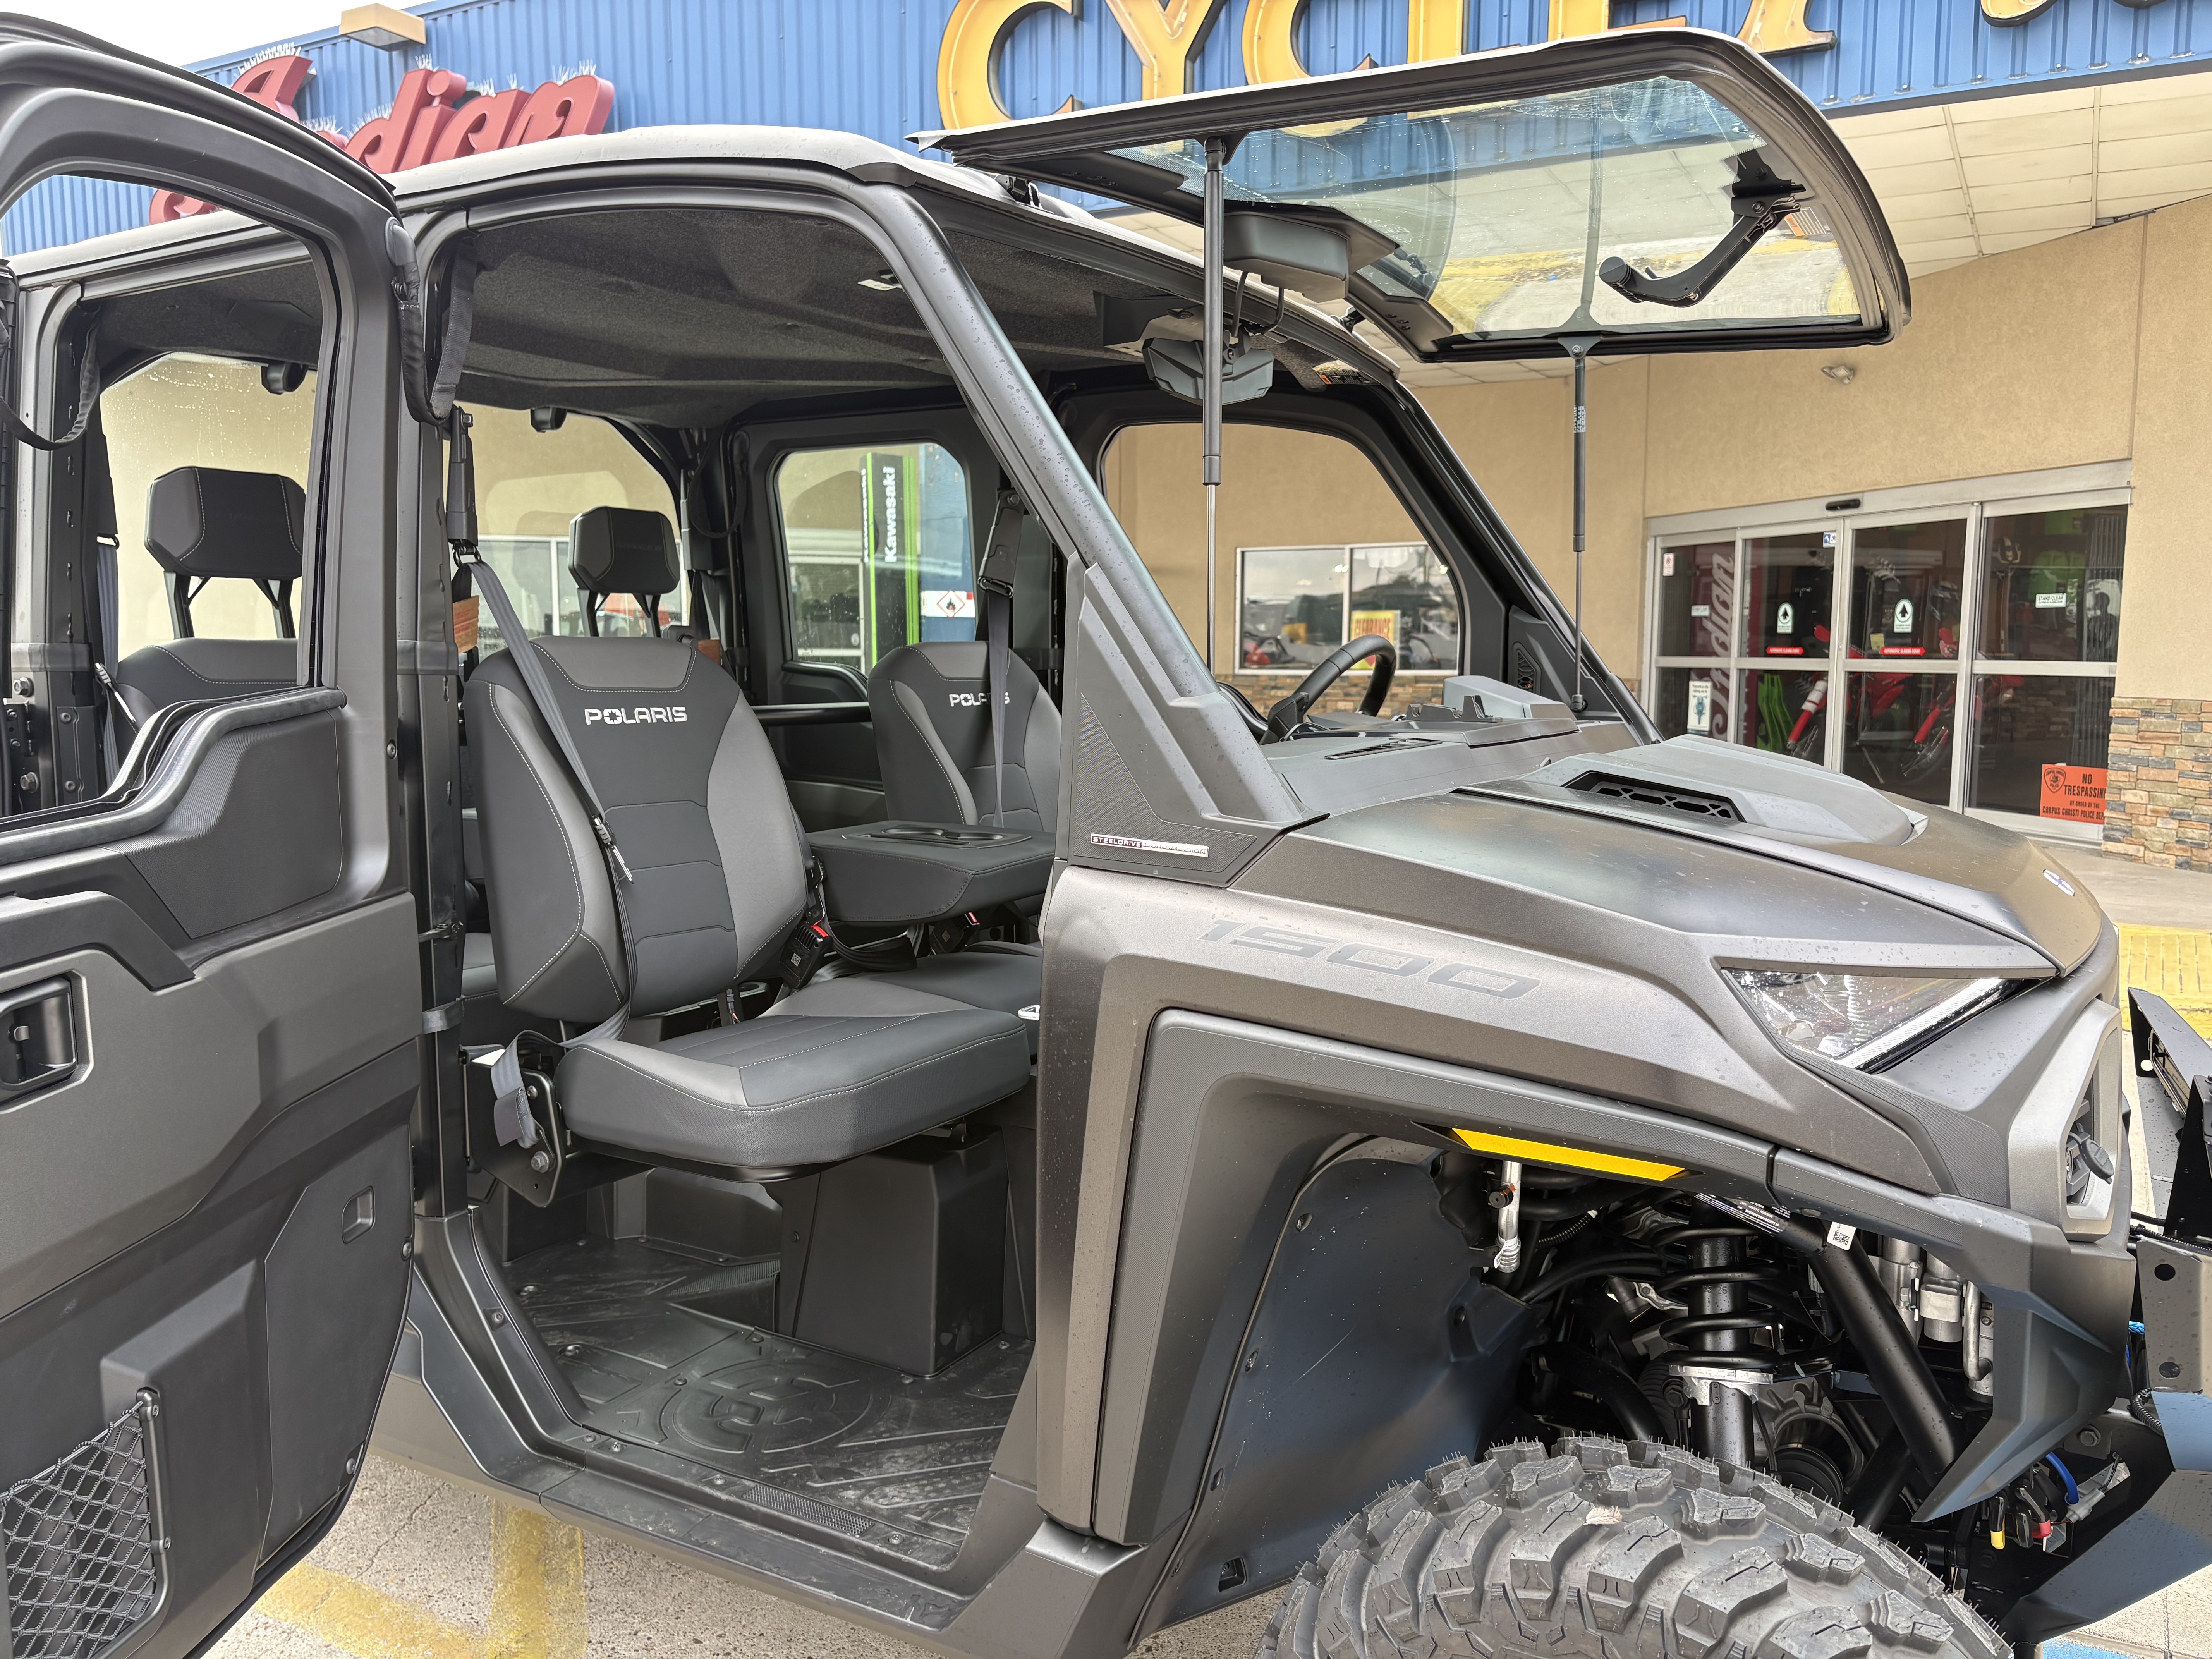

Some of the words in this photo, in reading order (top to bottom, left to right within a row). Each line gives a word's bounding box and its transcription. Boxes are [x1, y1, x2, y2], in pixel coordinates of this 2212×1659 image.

[883, 466, 897, 563] Kawasaki
[949, 692, 1010, 707] POLA
[584, 707, 688, 725] POLARIS
[2082, 773, 2092, 784] NO
[2043, 806, 2060, 815] CORPUS
[2062, 808, 2079, 817] CHRISTI
[2080, 810, 2095, 819] POLICE
[2096, 812, 2105, 820] DEP
[1093, 836, 1141, 847] STEELDRIVE
[1197, 919, 1542, 1000] 1500
